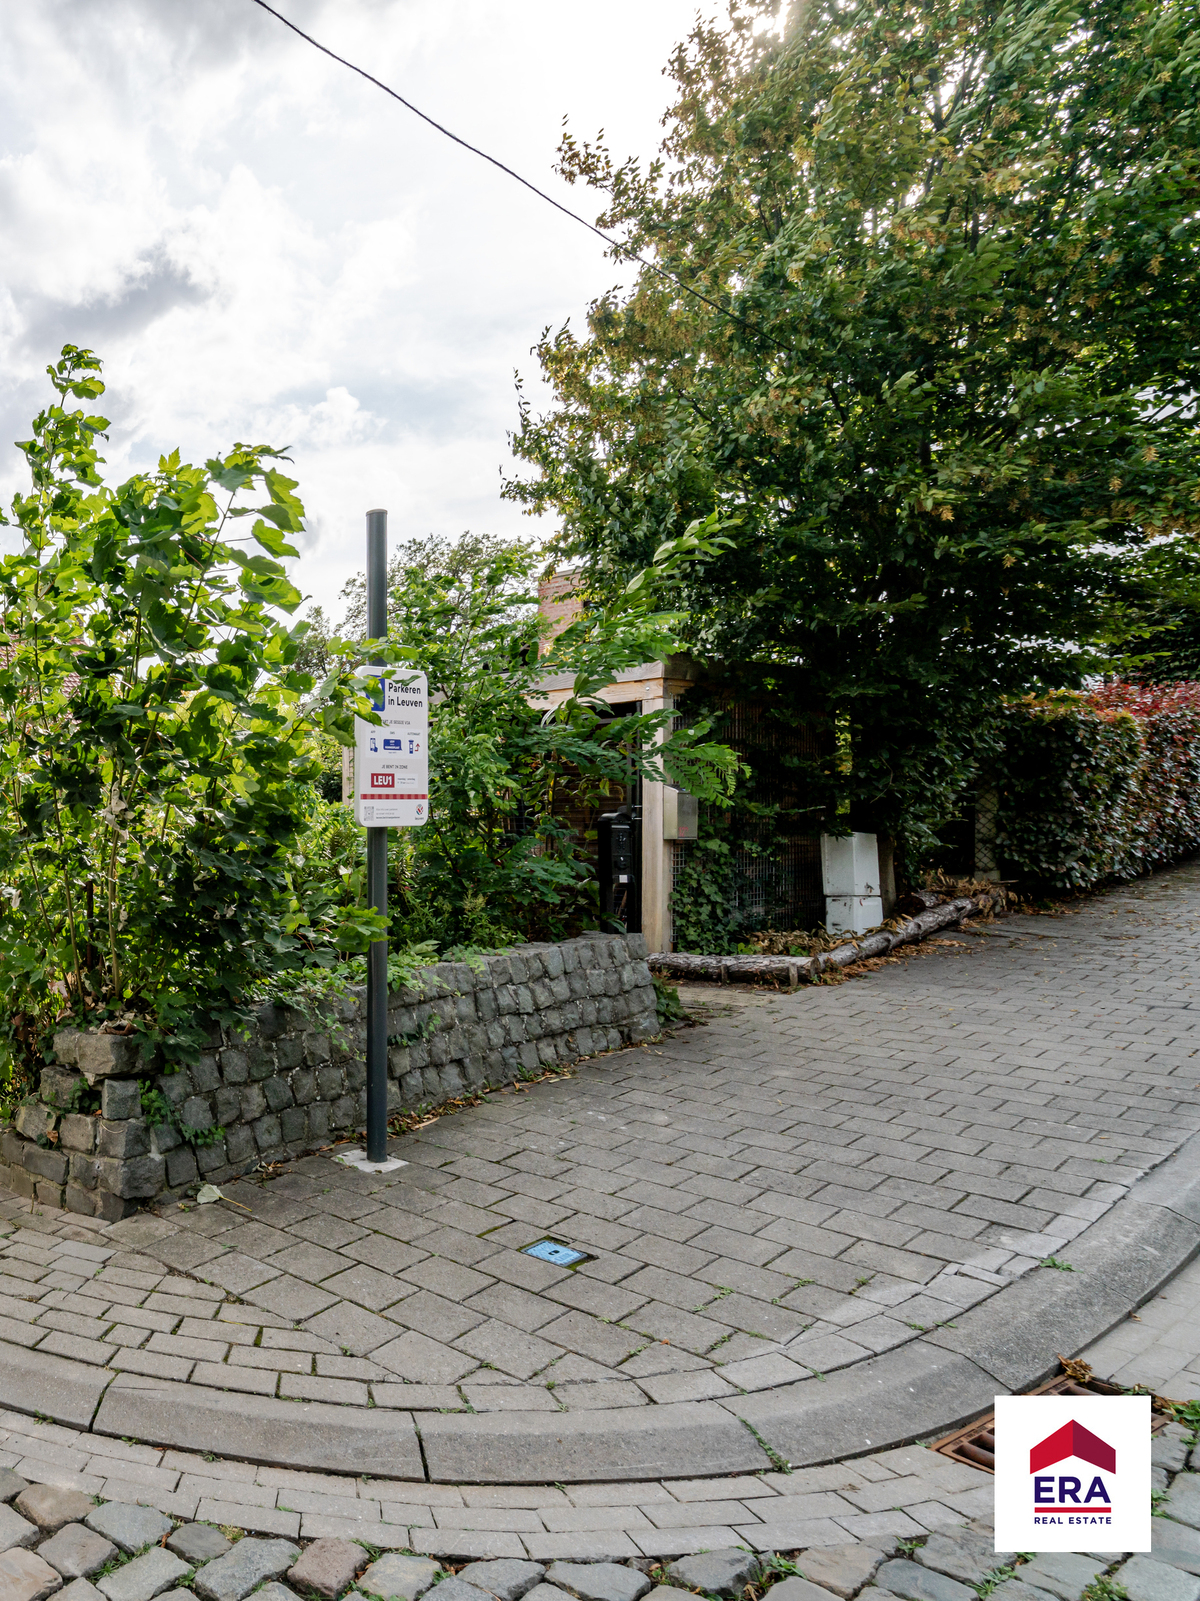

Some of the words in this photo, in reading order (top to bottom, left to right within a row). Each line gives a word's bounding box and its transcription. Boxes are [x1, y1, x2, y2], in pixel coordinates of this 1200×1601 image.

[388, 682, 421, 694] Parkeren
[388, 695, 395, 705] in
[397, 696, 423, 707] Leuven
[374, 776, 392, 785] LEU1
